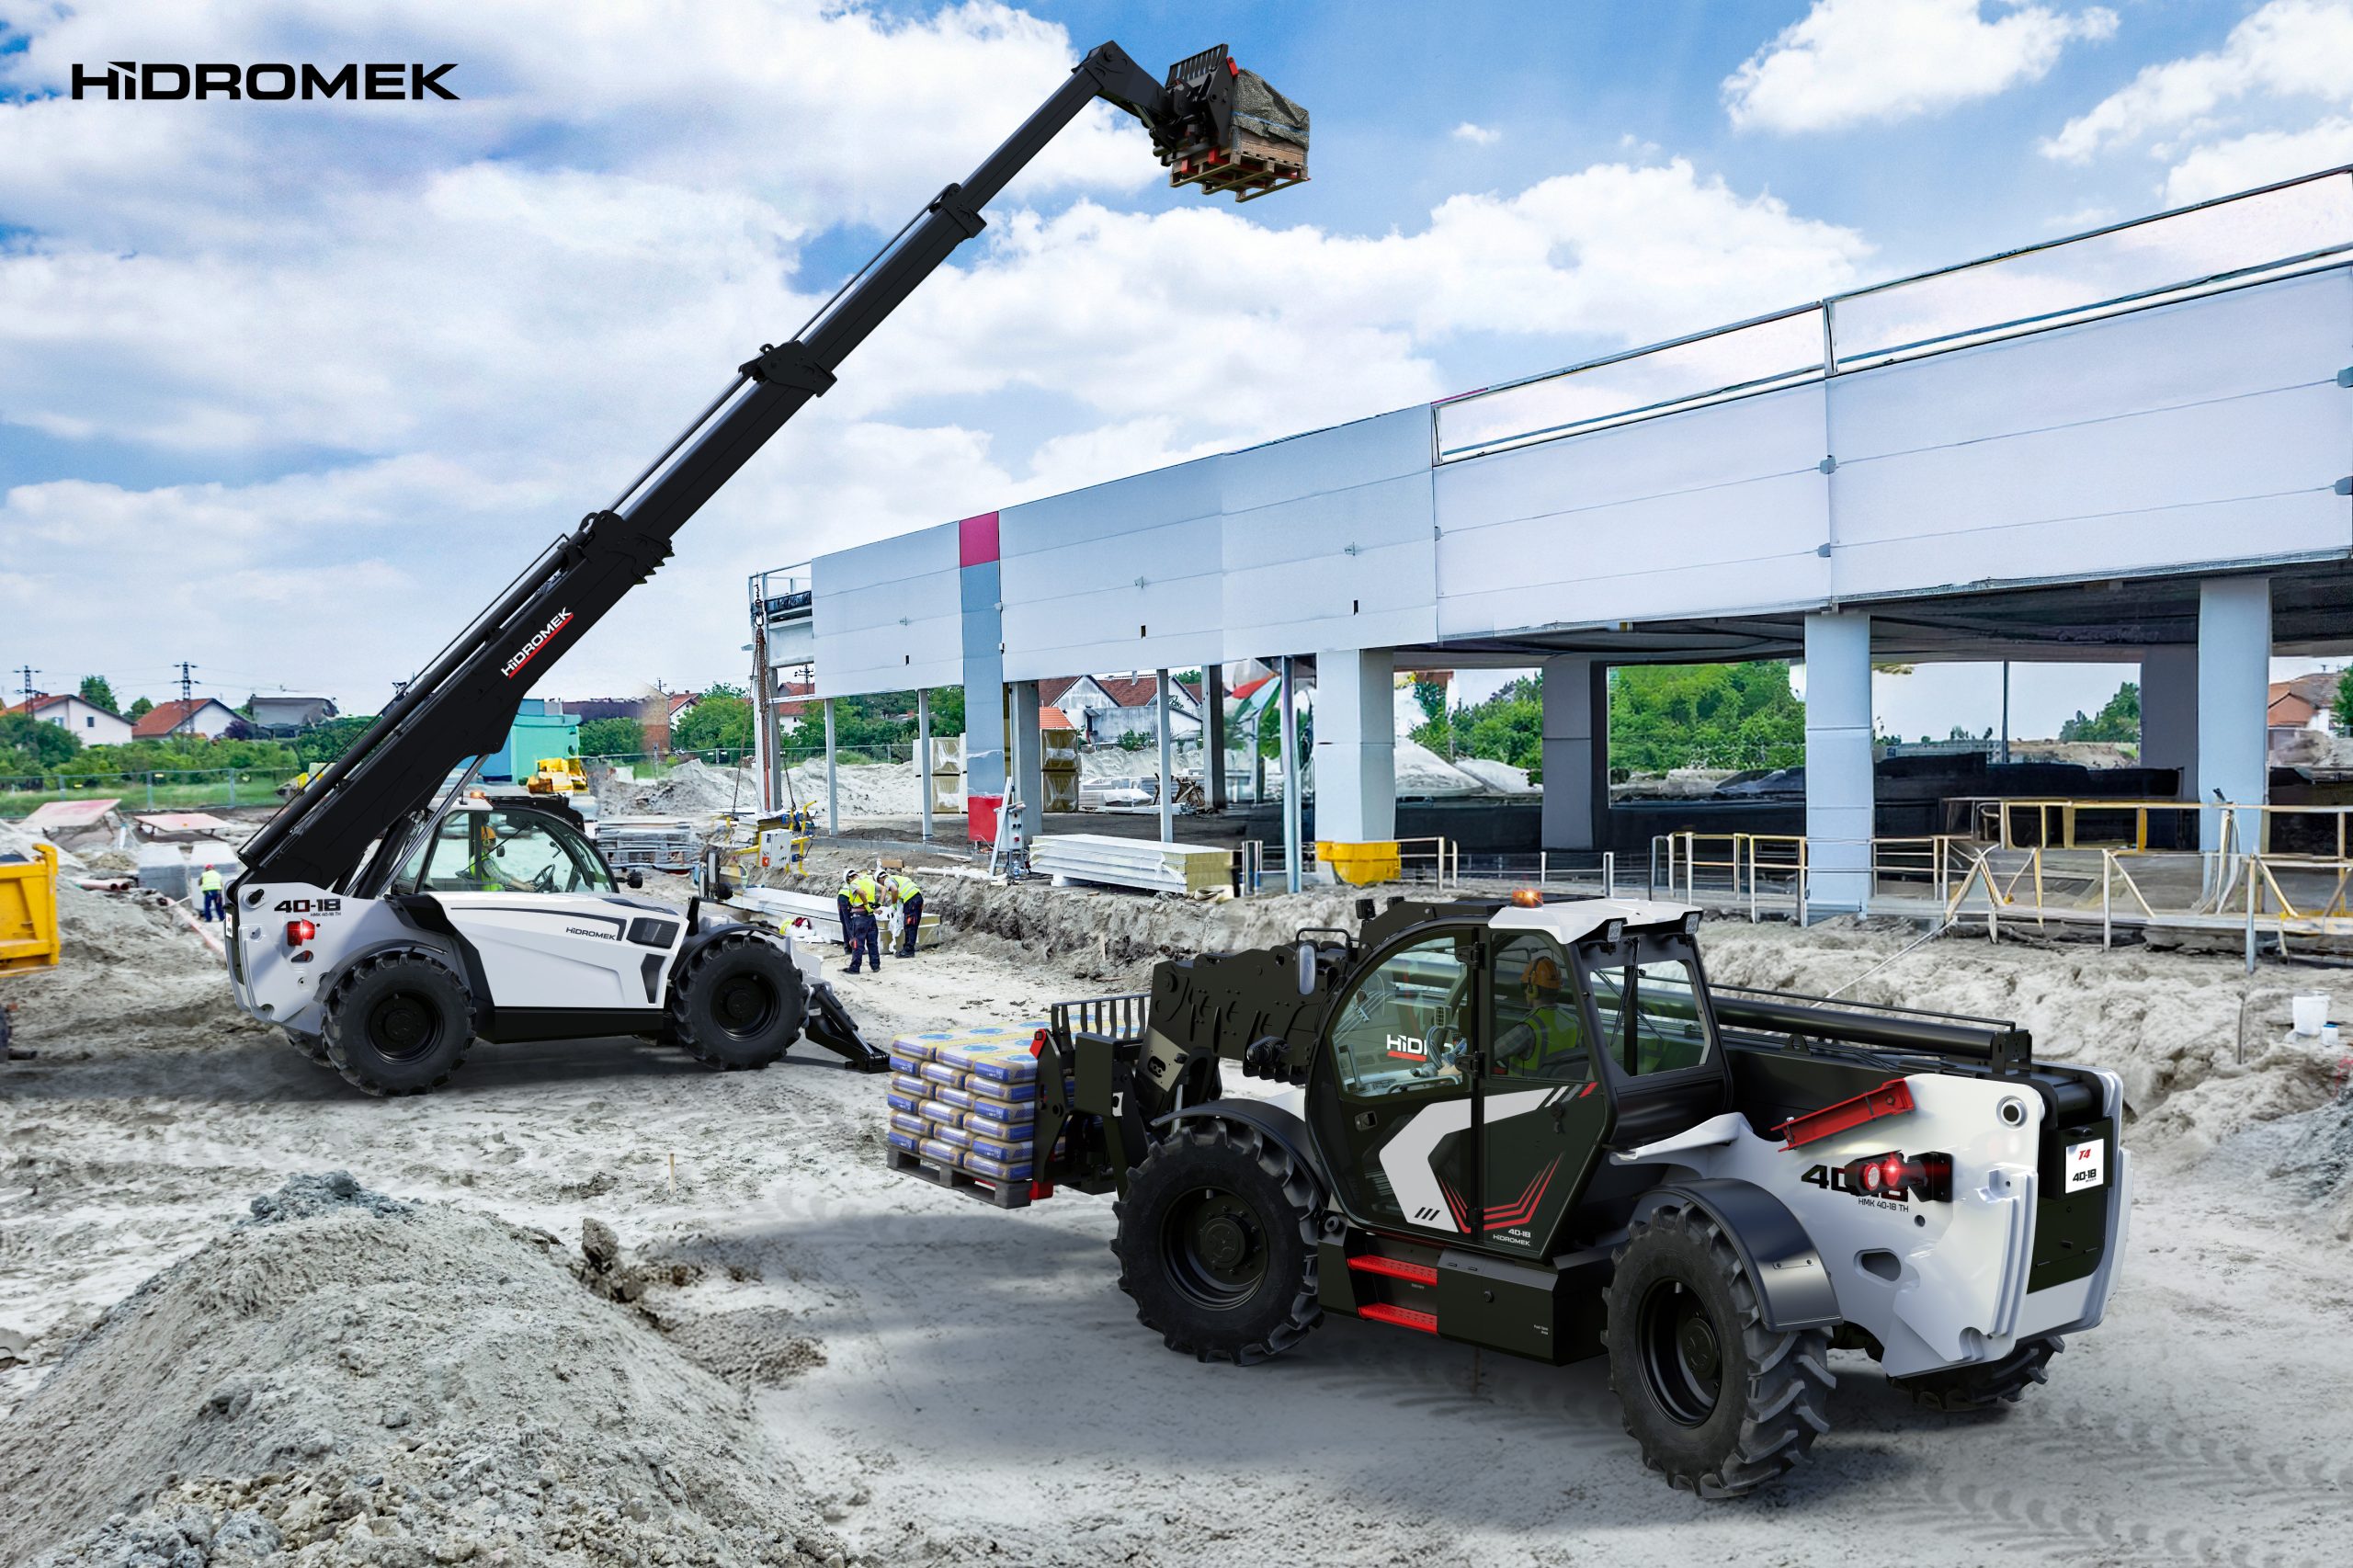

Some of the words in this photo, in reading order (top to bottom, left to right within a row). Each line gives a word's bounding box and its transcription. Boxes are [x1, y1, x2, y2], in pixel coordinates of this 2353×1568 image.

[274, 898, 341, 913] 40-18
[2072, 1168, 2097, 1182] 40-18
[1858, 1198, 1876, 1208] HMK
[1876, 1200, 1897, 1211] 40-18
[1898, 1204, 1909, 1213] TH
[1507, 1228, 1531, 1238] 40-18
